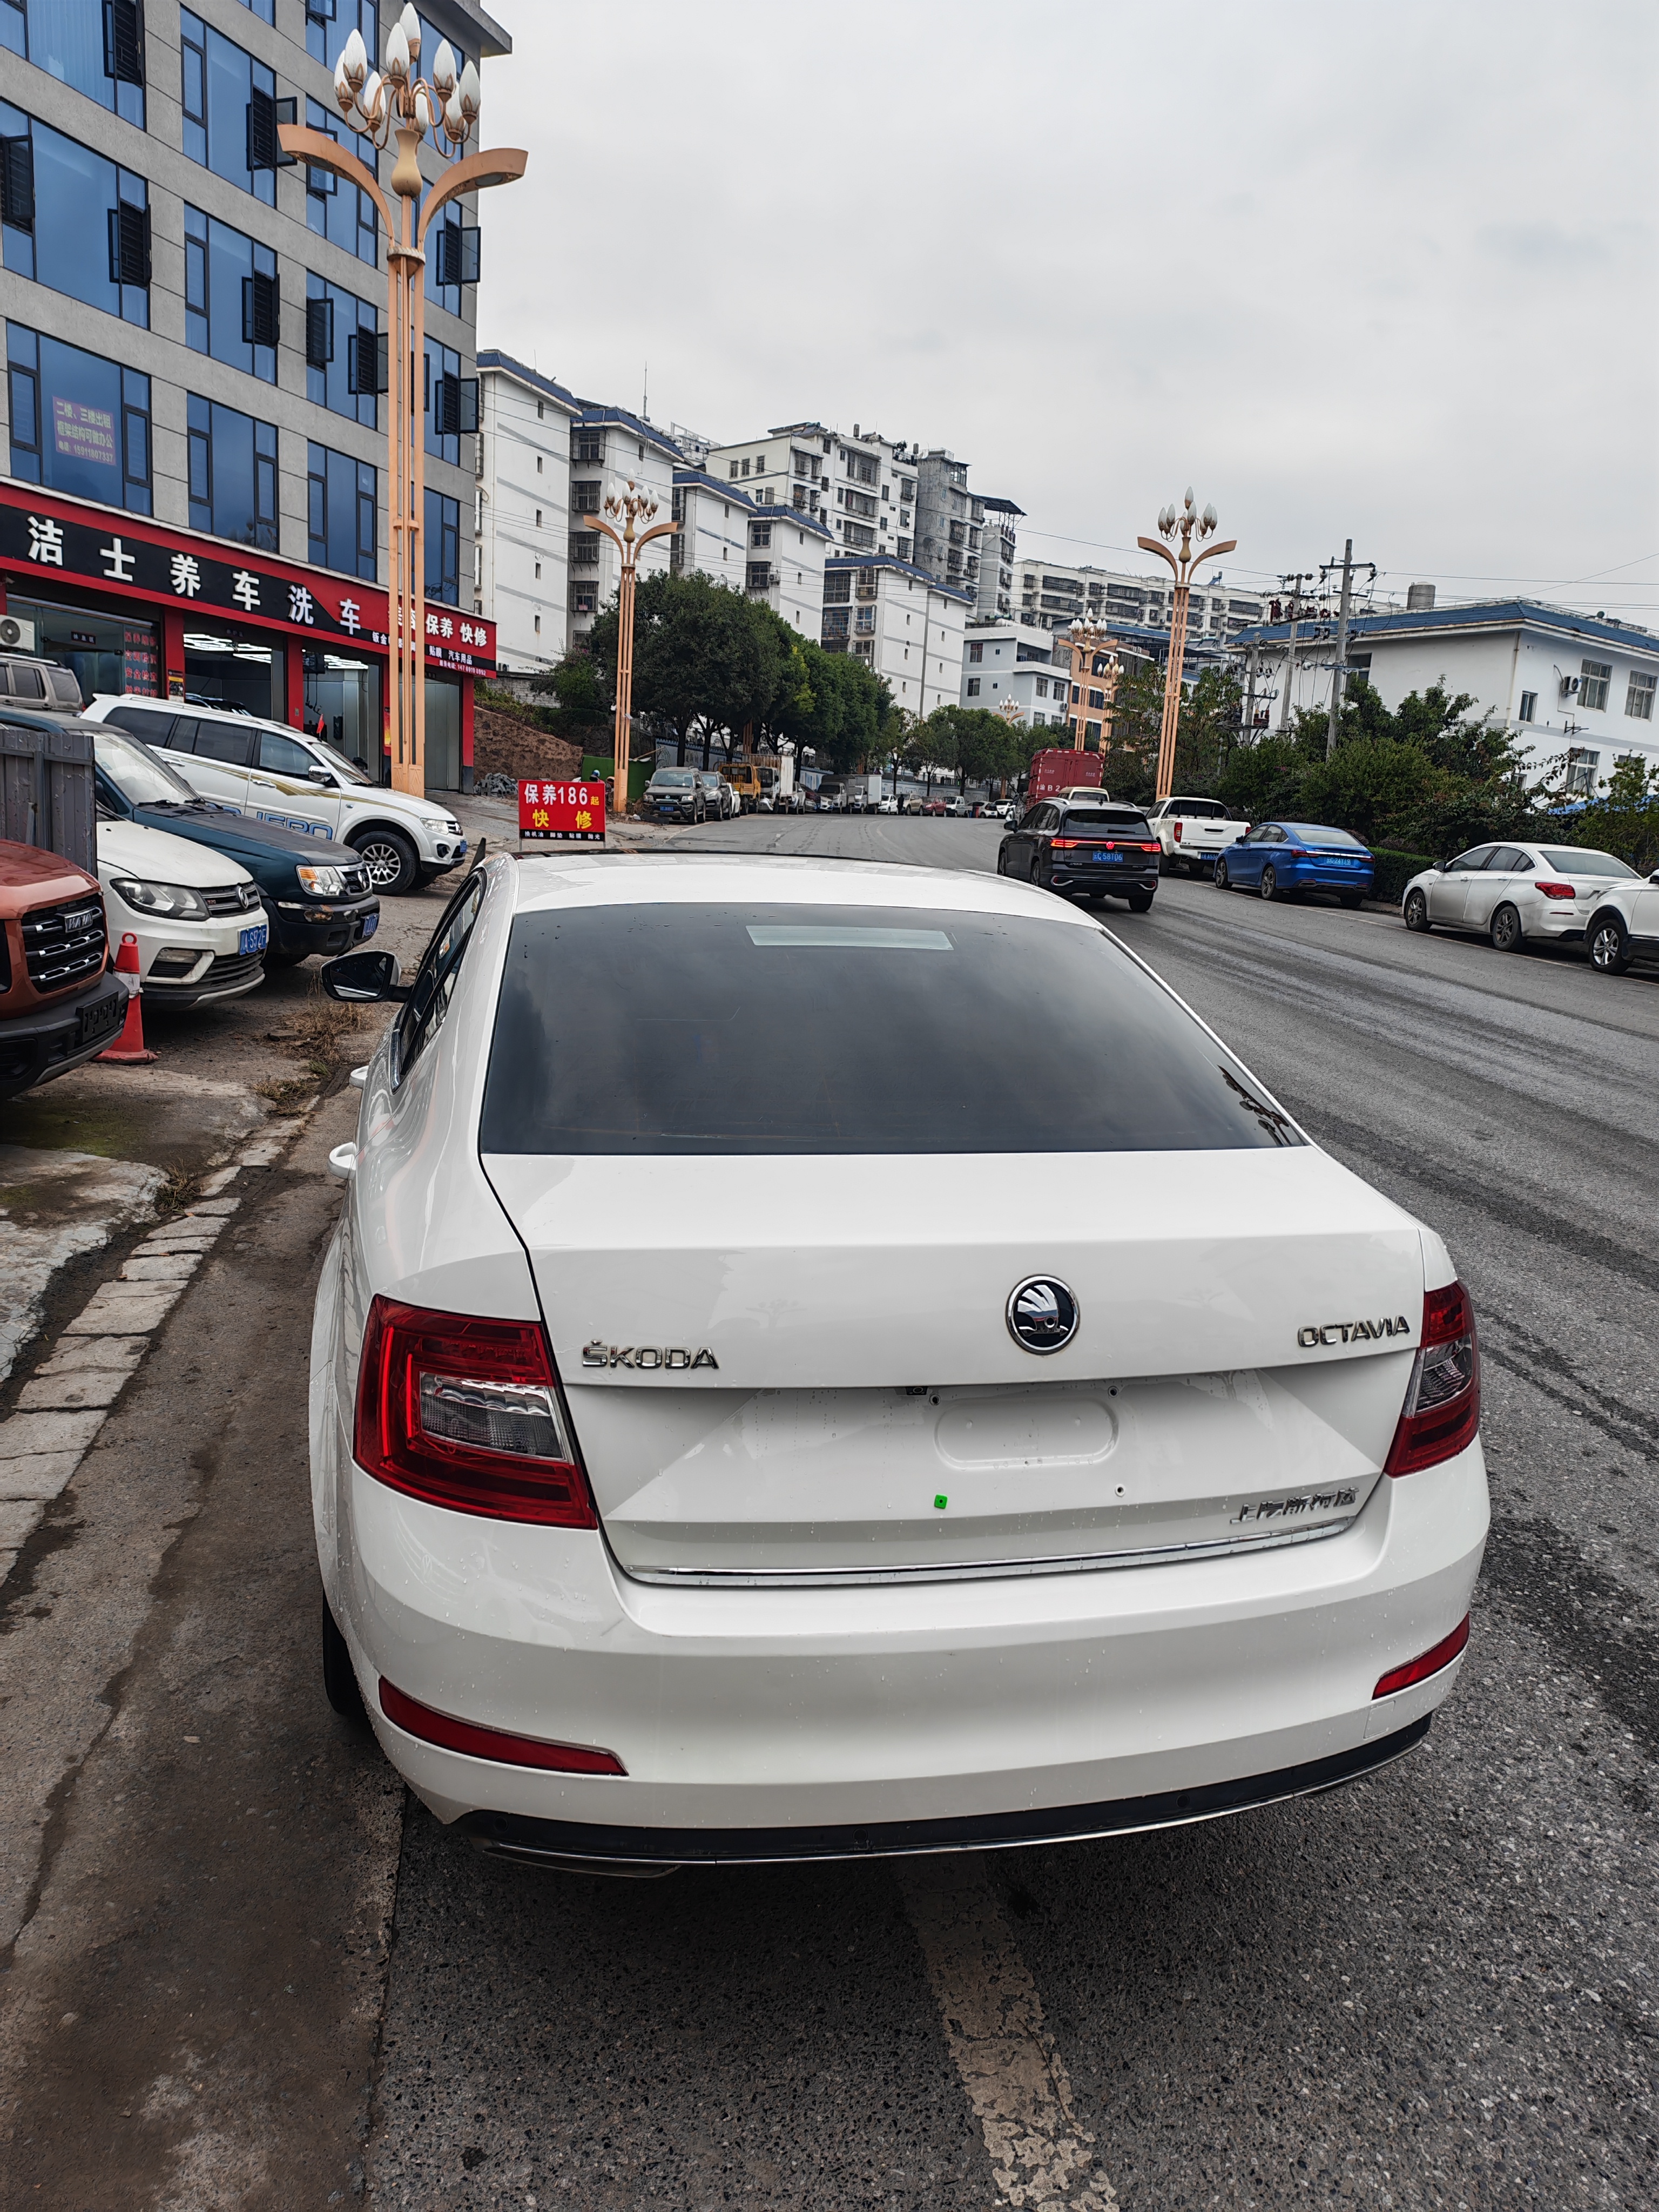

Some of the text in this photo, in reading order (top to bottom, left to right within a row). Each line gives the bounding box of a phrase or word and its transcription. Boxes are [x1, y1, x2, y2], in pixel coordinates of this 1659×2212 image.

[56, 401, 111, 429] 二楼、三楼出租
[27, 515, 361, 635] 洁士养车洗车
[425, 613, 453, 638] 保养
[460, 623, 487, 646] 快修
[429, 646, 442, 658] 贴膜
[448, 650, 473, 665] 汽车用品
[1298, 1315, 1410, 1347] OCTAVIA
[583, 1339, 720, 1370] ŠKODA
